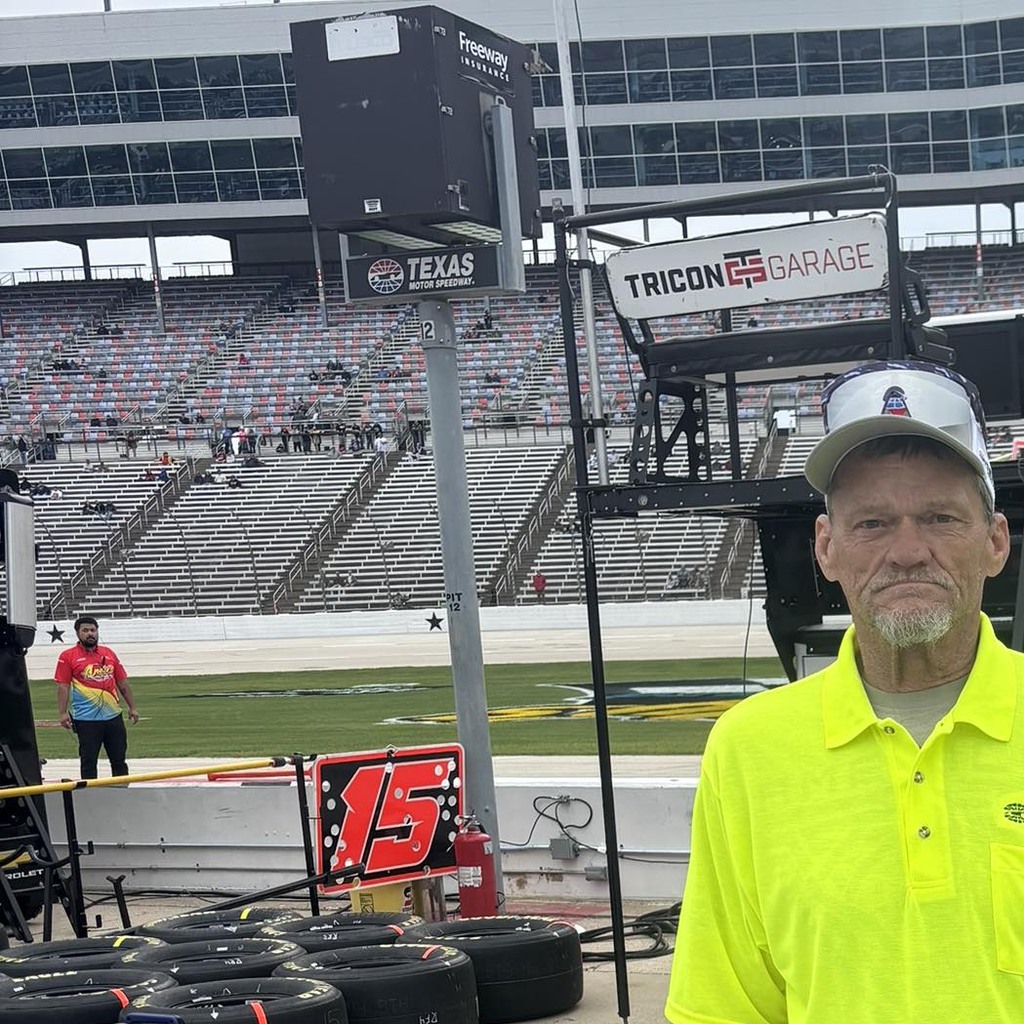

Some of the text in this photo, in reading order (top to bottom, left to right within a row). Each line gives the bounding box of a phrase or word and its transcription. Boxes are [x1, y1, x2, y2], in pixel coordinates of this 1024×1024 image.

[459, 31, 508, 72] Freeway
[461, 56, 509, 82] INSURANCE
[407, 252, 474, 281] TEXAS
[624, 243, 874, 299] TRICON GARAGE
[409, 279, 434, 290] MOTOR
[420, 321, 433, 340] 12
[446, 592, 463, 602] PIT
[449, 602, 461, 612] 12
[331, 757, 455, 875] 15
